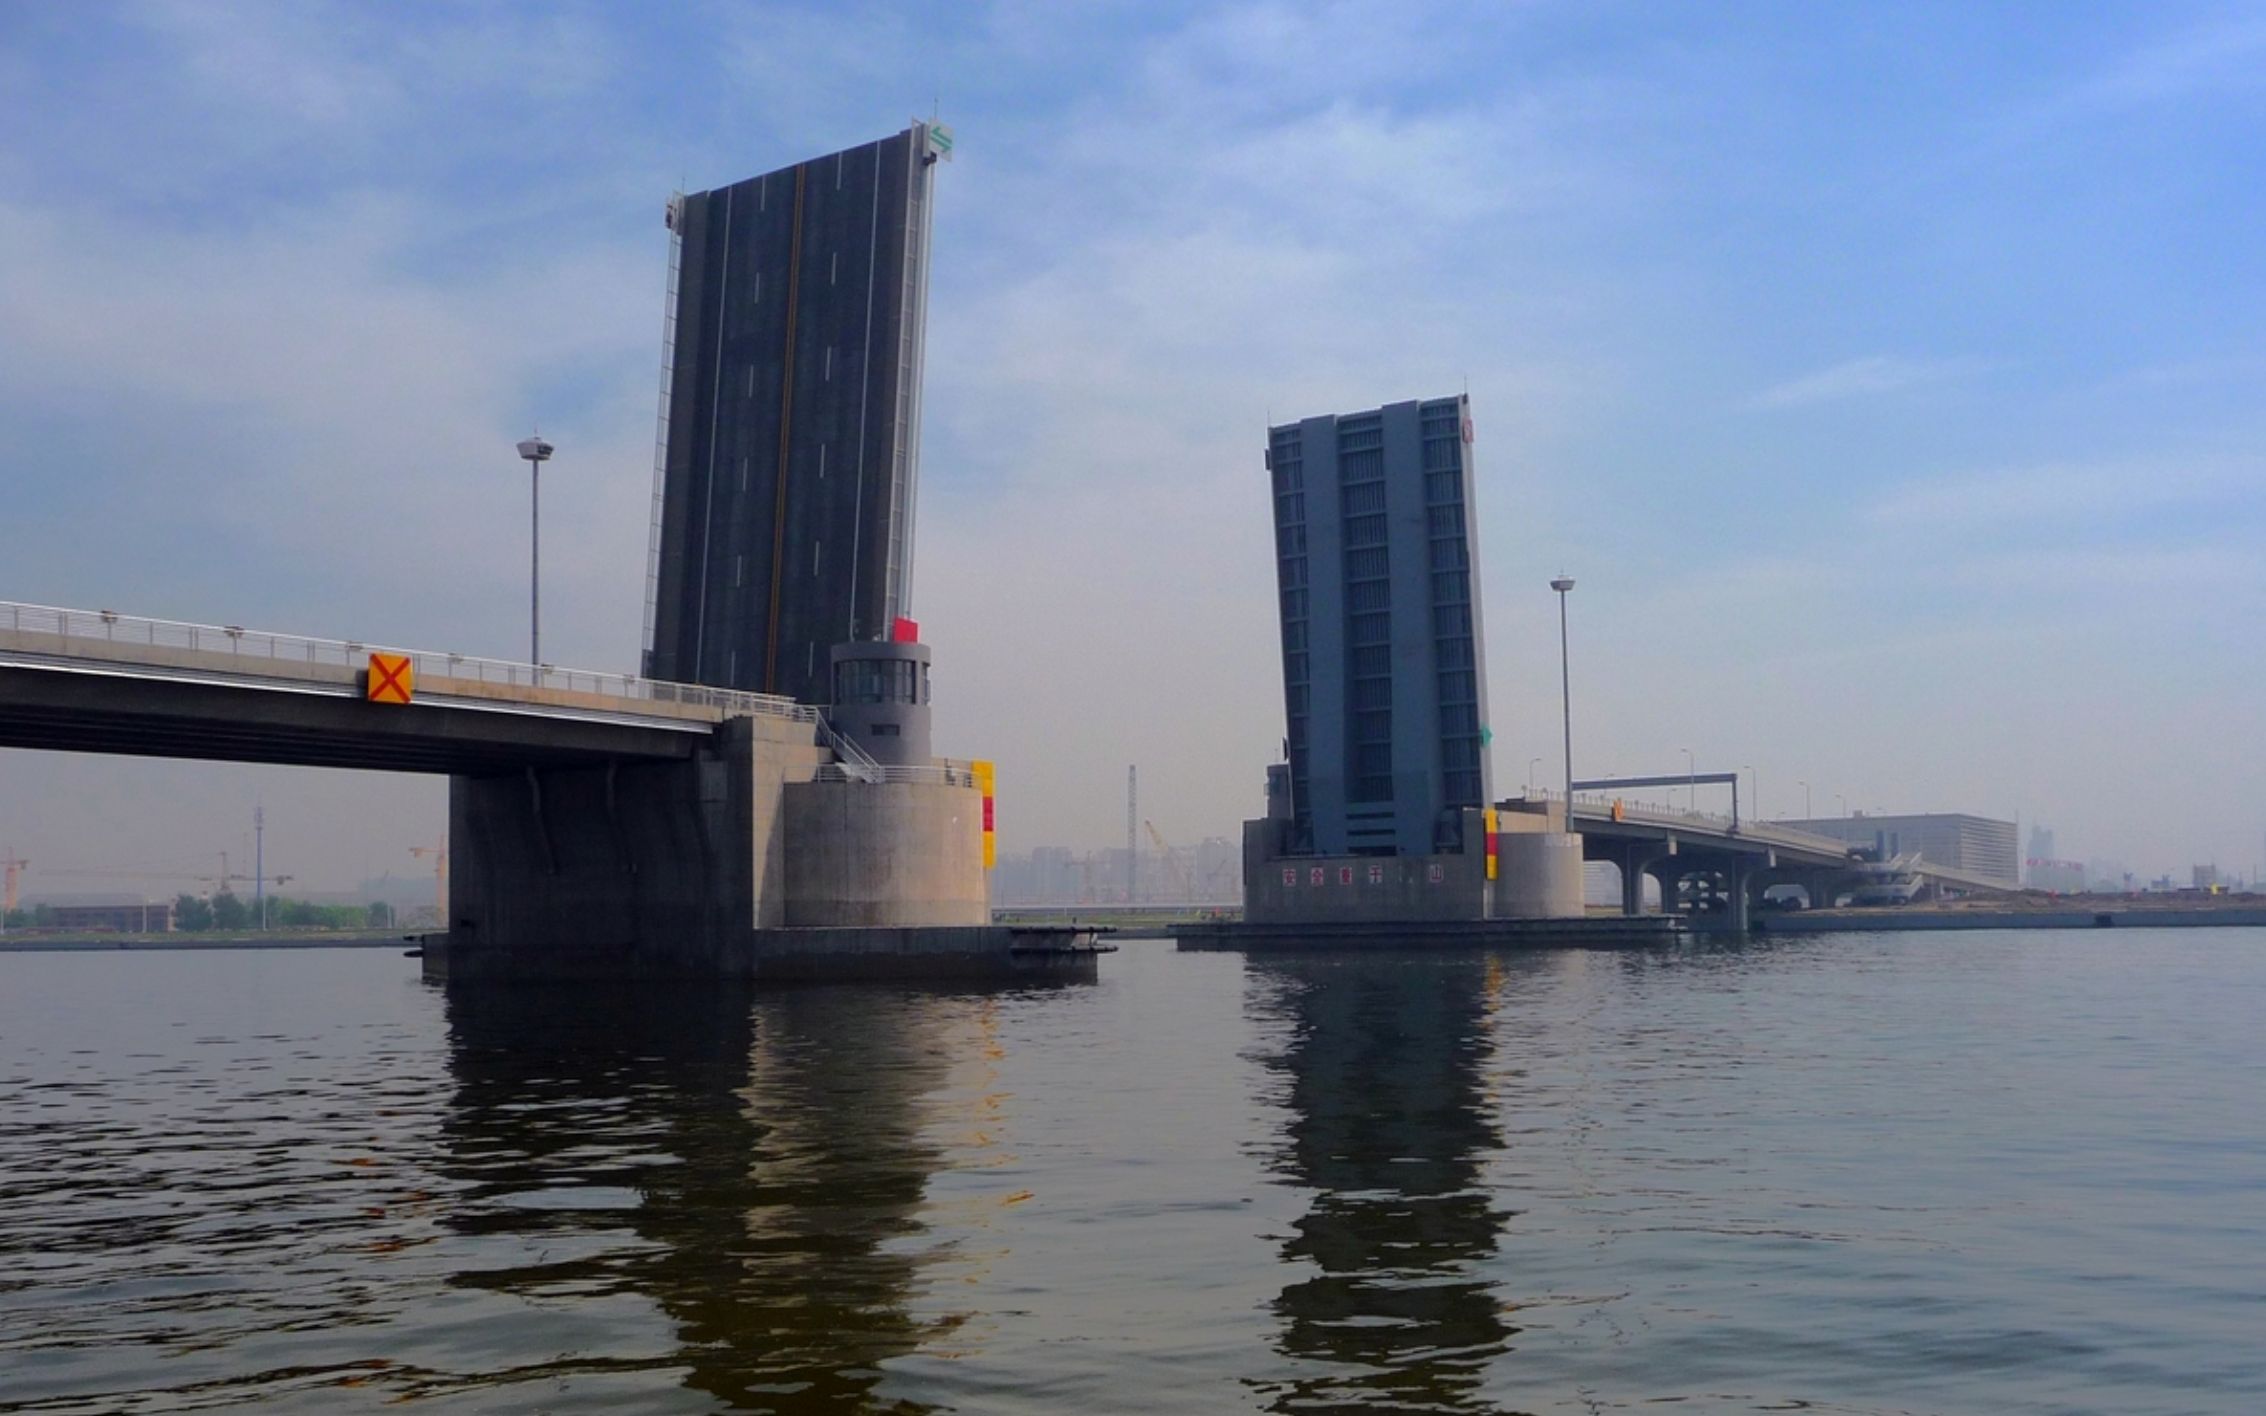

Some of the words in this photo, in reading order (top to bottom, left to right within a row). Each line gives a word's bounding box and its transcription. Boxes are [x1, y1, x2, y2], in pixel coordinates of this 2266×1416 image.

[1283, 864, 1443, 887] 安全重于山
